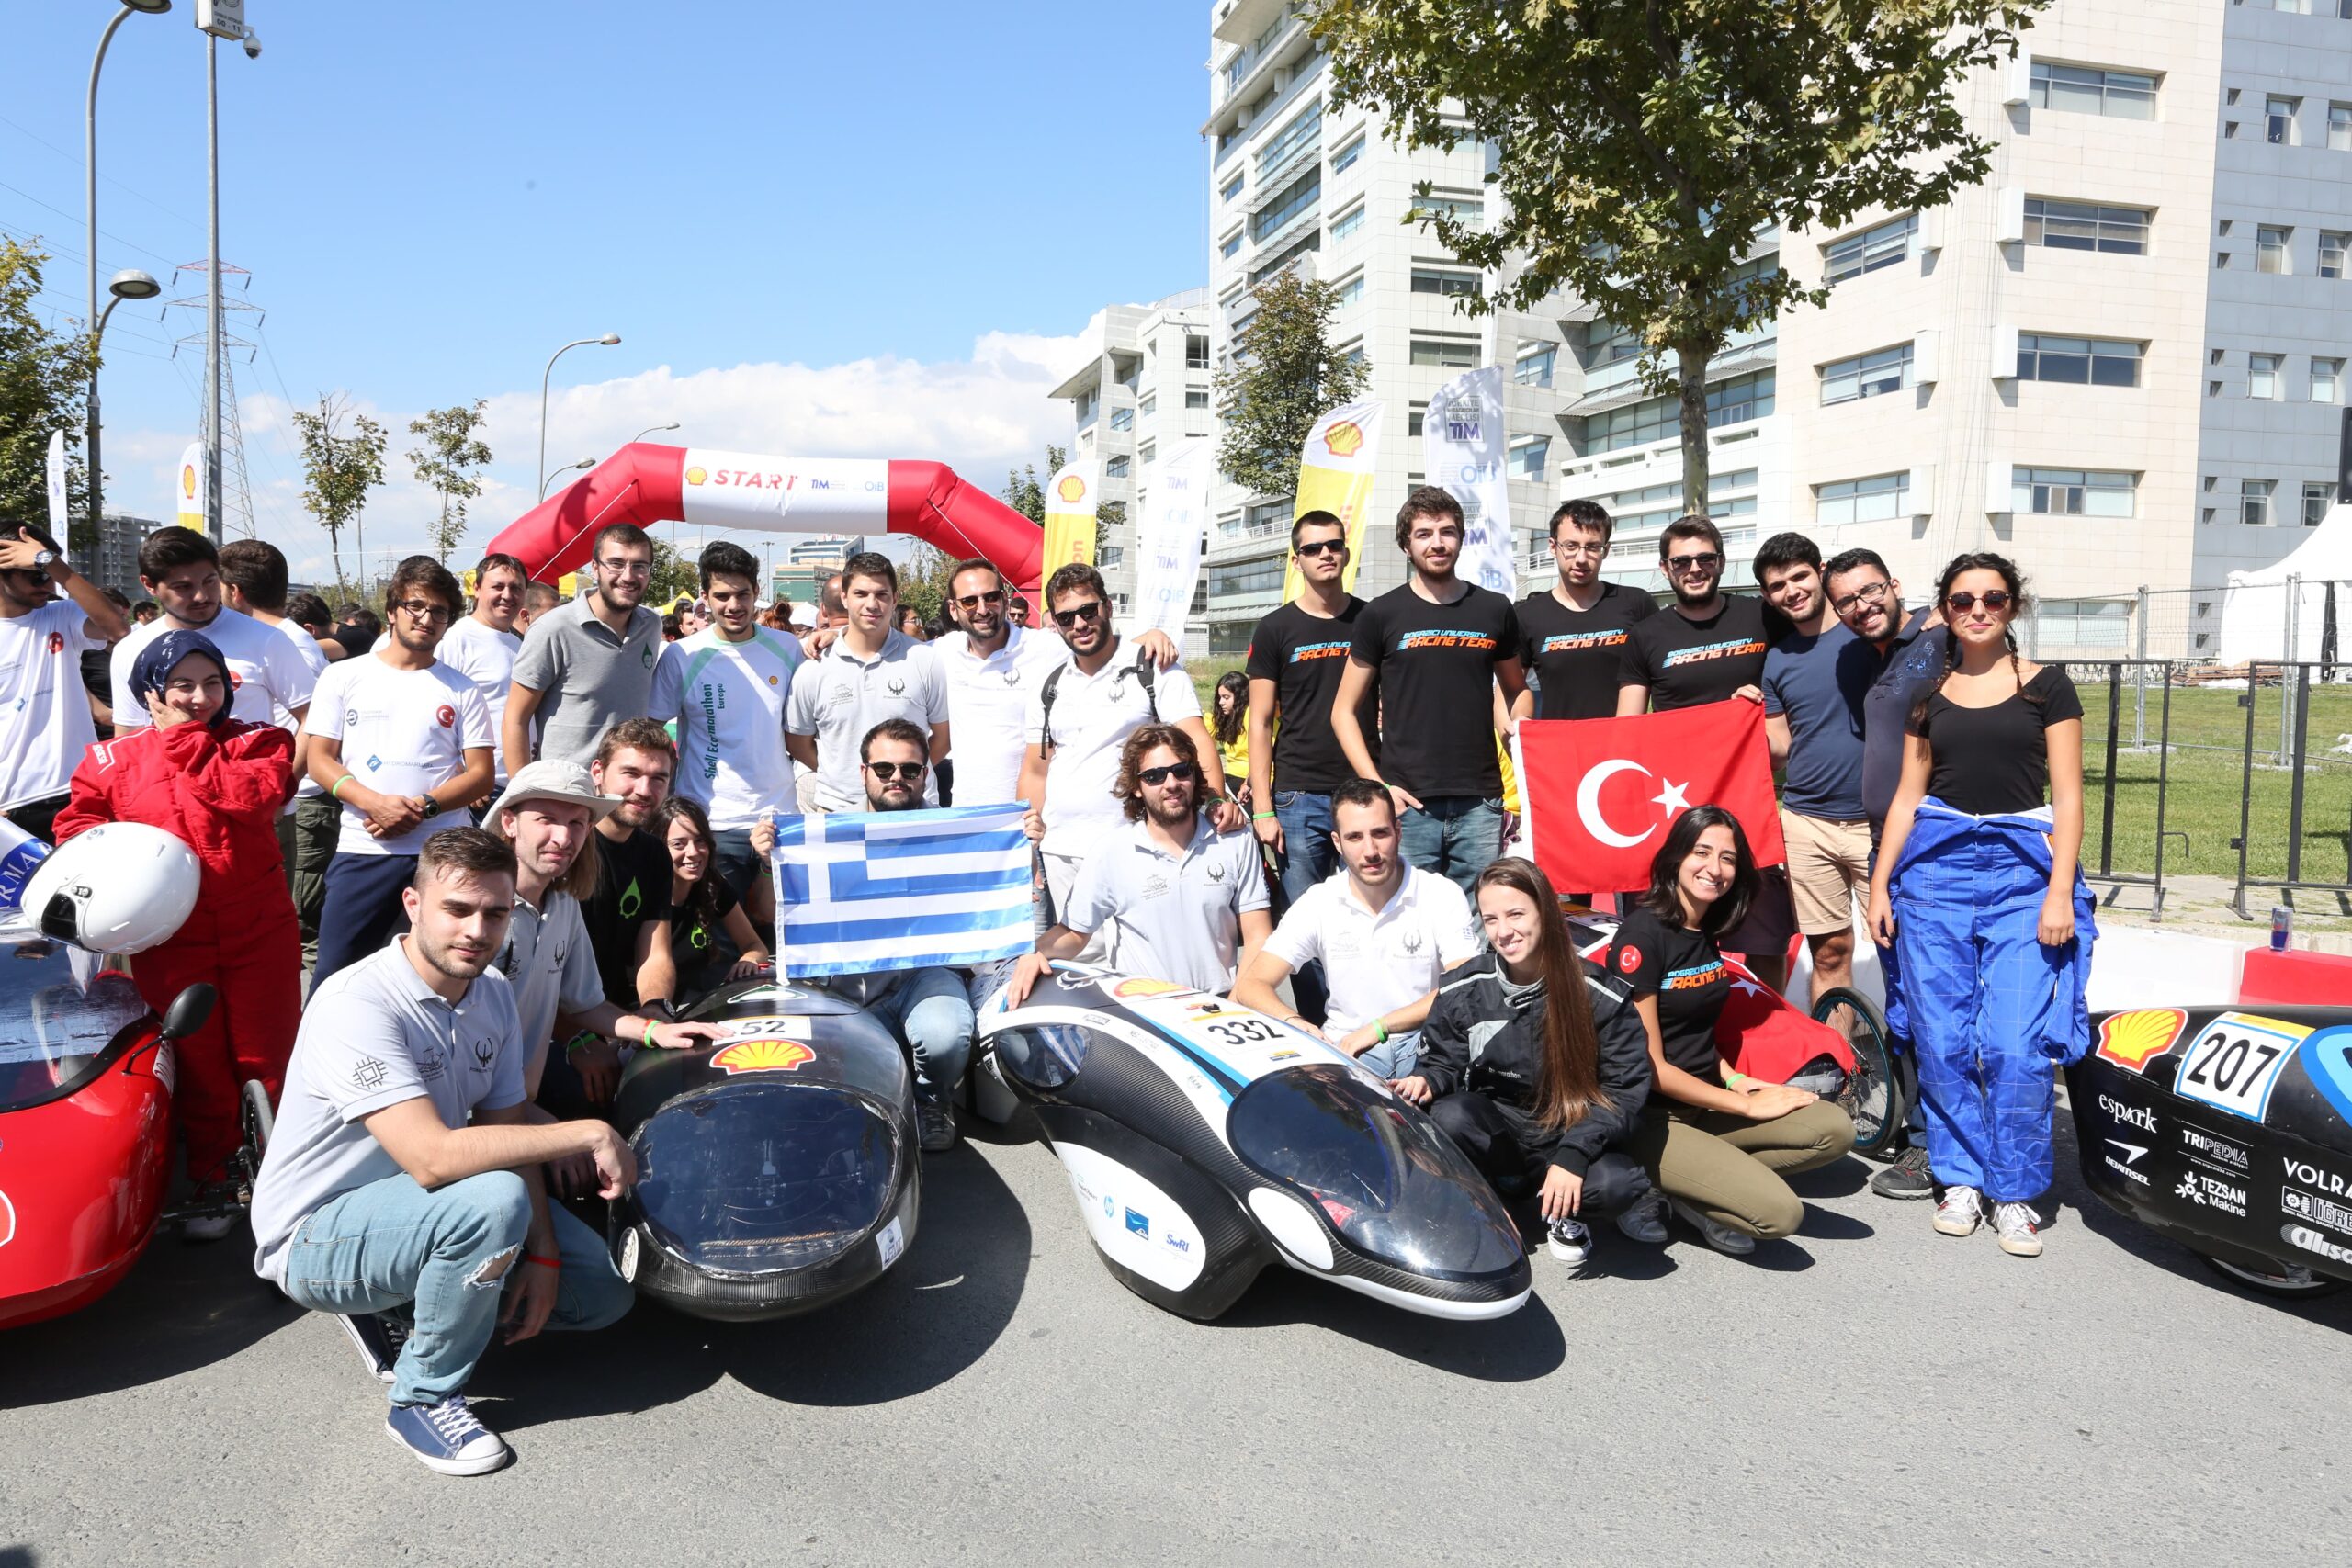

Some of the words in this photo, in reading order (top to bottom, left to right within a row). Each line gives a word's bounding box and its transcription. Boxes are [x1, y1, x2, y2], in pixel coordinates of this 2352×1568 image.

[714, 469, 799, 491] START
[1297, 648, 1342, 661] RACING
[1406, 636, 1456, 649] RACING
[1458, 637, 1497, 650] TEAM
[1548, 638, 1594, 651] RACING
[1671, 649, 1724, 666] RACING
[1725, 642, 1766, 657] TEAM
[718, 682, 726, 709] Europe
[704, 754, 718, 780] Shell
[1668, 973, 1715, 990] RACING
[741, 1021, 786, 1035] 52
[1207, 1020, 1286, 1045] 332
[2187, 1032, 2281, 1098] 207
[2183, 1129, 2249, 1166] TRIPEDIA
[2200, 1176, 2246, 1206] TEZSAN
[2209, 1194, 2246, 1217] Makine
[1166, 1234, 1190, 1253] SwRI
